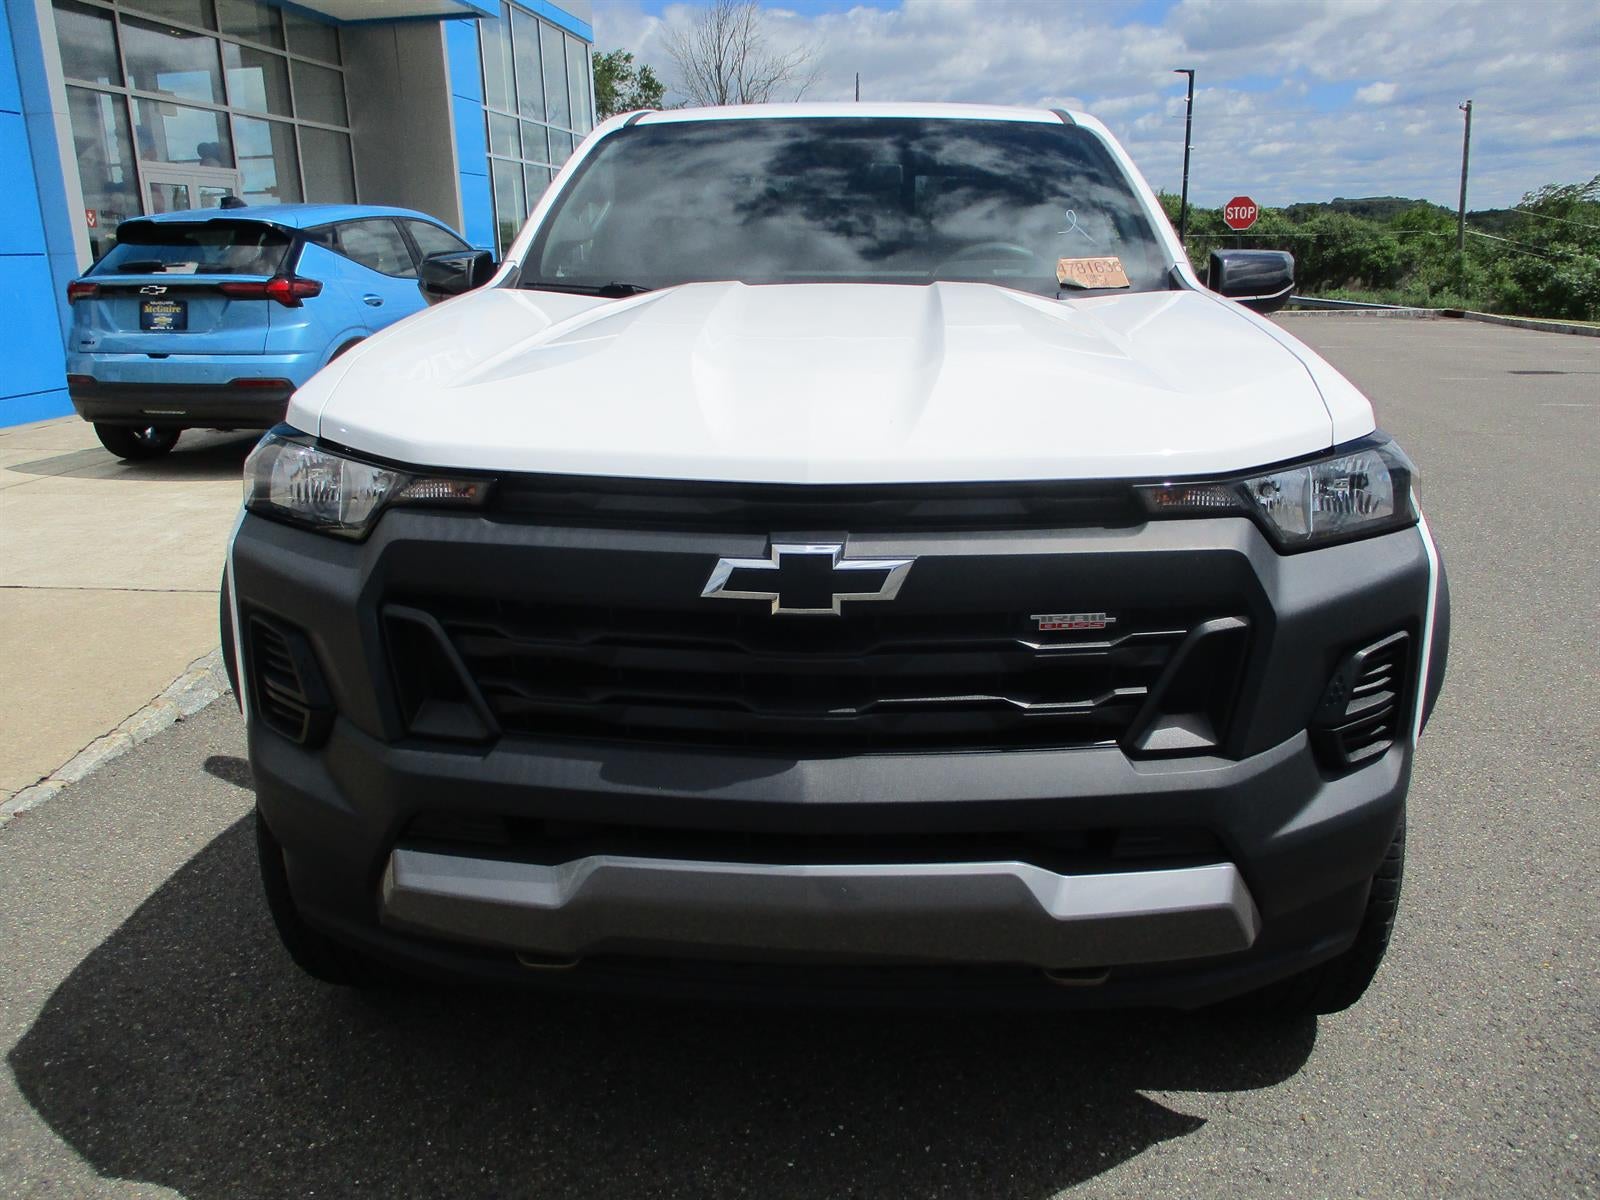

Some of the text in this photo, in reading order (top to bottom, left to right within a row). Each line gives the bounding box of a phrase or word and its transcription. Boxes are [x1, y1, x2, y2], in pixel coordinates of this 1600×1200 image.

[1226, 206, 1255, 219] STOP
[1030, 612, 1116, 623] TRAIL
[1039, 620, 1106, 630] BOSS
